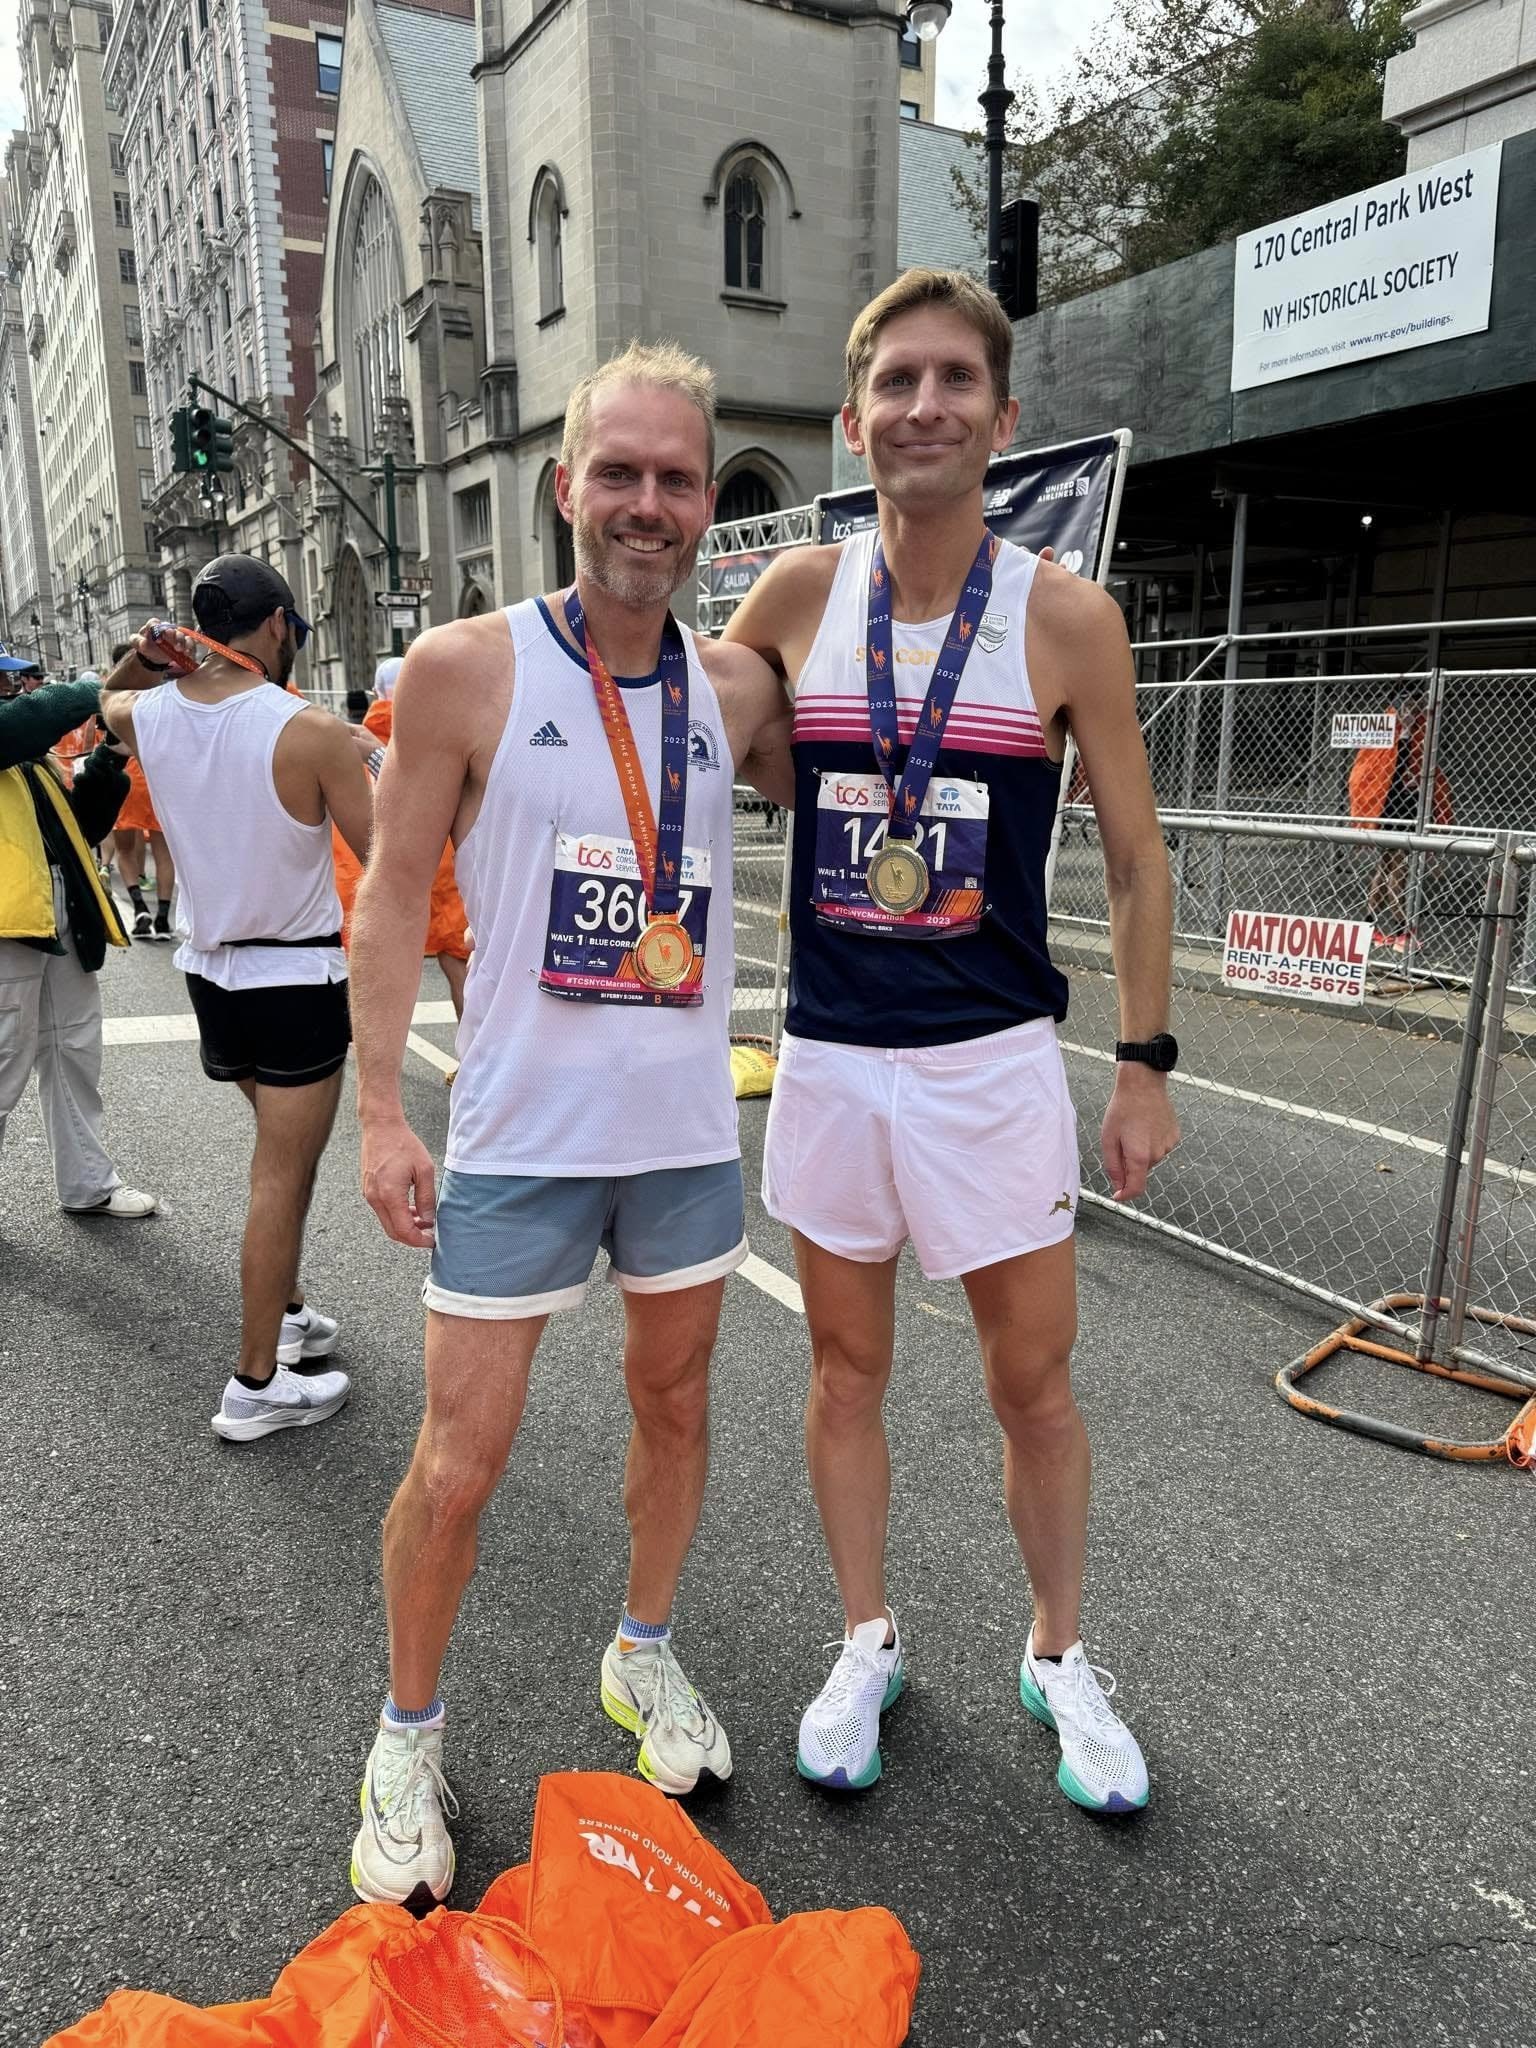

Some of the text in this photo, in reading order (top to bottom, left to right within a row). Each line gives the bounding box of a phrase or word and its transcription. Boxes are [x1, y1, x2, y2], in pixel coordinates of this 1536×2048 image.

[1254, 169, 1474, 270] 170 Central Park West
[1263, 251, 1459, 332] NY HISTORICAL SOCIETY
[1259, 313, 1454, 372] For more information, visit www.nyc.gov/buildings.
[1045, 480, 1074, 493] UNITED
[1037, 488, 1074, 503] AIRLINES
[832, 520, 852, 540] tcs
[724, 571, 751, 589] SALIDA
[966, 586, 989, 598] 2023
[868, 614, 889, 626] 2023
[663, 653, 684, 661] 2023
[856, 647, 938, 665] scon
[936, 668, 960, 681] 2023
[604, 681, 619, 723] QUEENS
[870, 700, 894, 709] 2023
[1334, 715, 1393, 731] NATIONAL
[529, 737, 568, 747] adidas
[618, 738, 629, 757] THE
[664, 736, 686, 745] 2023
[910, 757, 934, 769] 2023
[835, 783, 869, 806] tcs
[936, 803, 961, 811] TATA
[661, 823, 682, 833] 2023
[637, 810, 657, 874] MANHATTAN
[577, 842, 612, 869] tcs
[616, 847, 634, 856] TATA
[616, 864, 641, 873] SERVICE
[680, 870, 695, 880] ATA
[818, 868, 837, 877] WAVE
[840, 869, 845, 879] 1
[926, 915, 951, 925] 2023
[551, 934, 638, 949] WAVE 1 BLUE CORRA
[1229, 913, 1363, 964] NATIONAL
[1227, 950, 1362, 979] RENT-A-FENCE
[566, 977, 641, 990] #TCSNYCMarathon
[1226, 965, 1360, 996] 800-352-5675
[655, 994, 662, 1004] B
[578, 1818, 639, 1840] RUNNERS
[642, 1838, 673, 1867] ROAD
[674, 1862, 702, 1890] YORK
[704, 1887, 731, 1913] NEW
